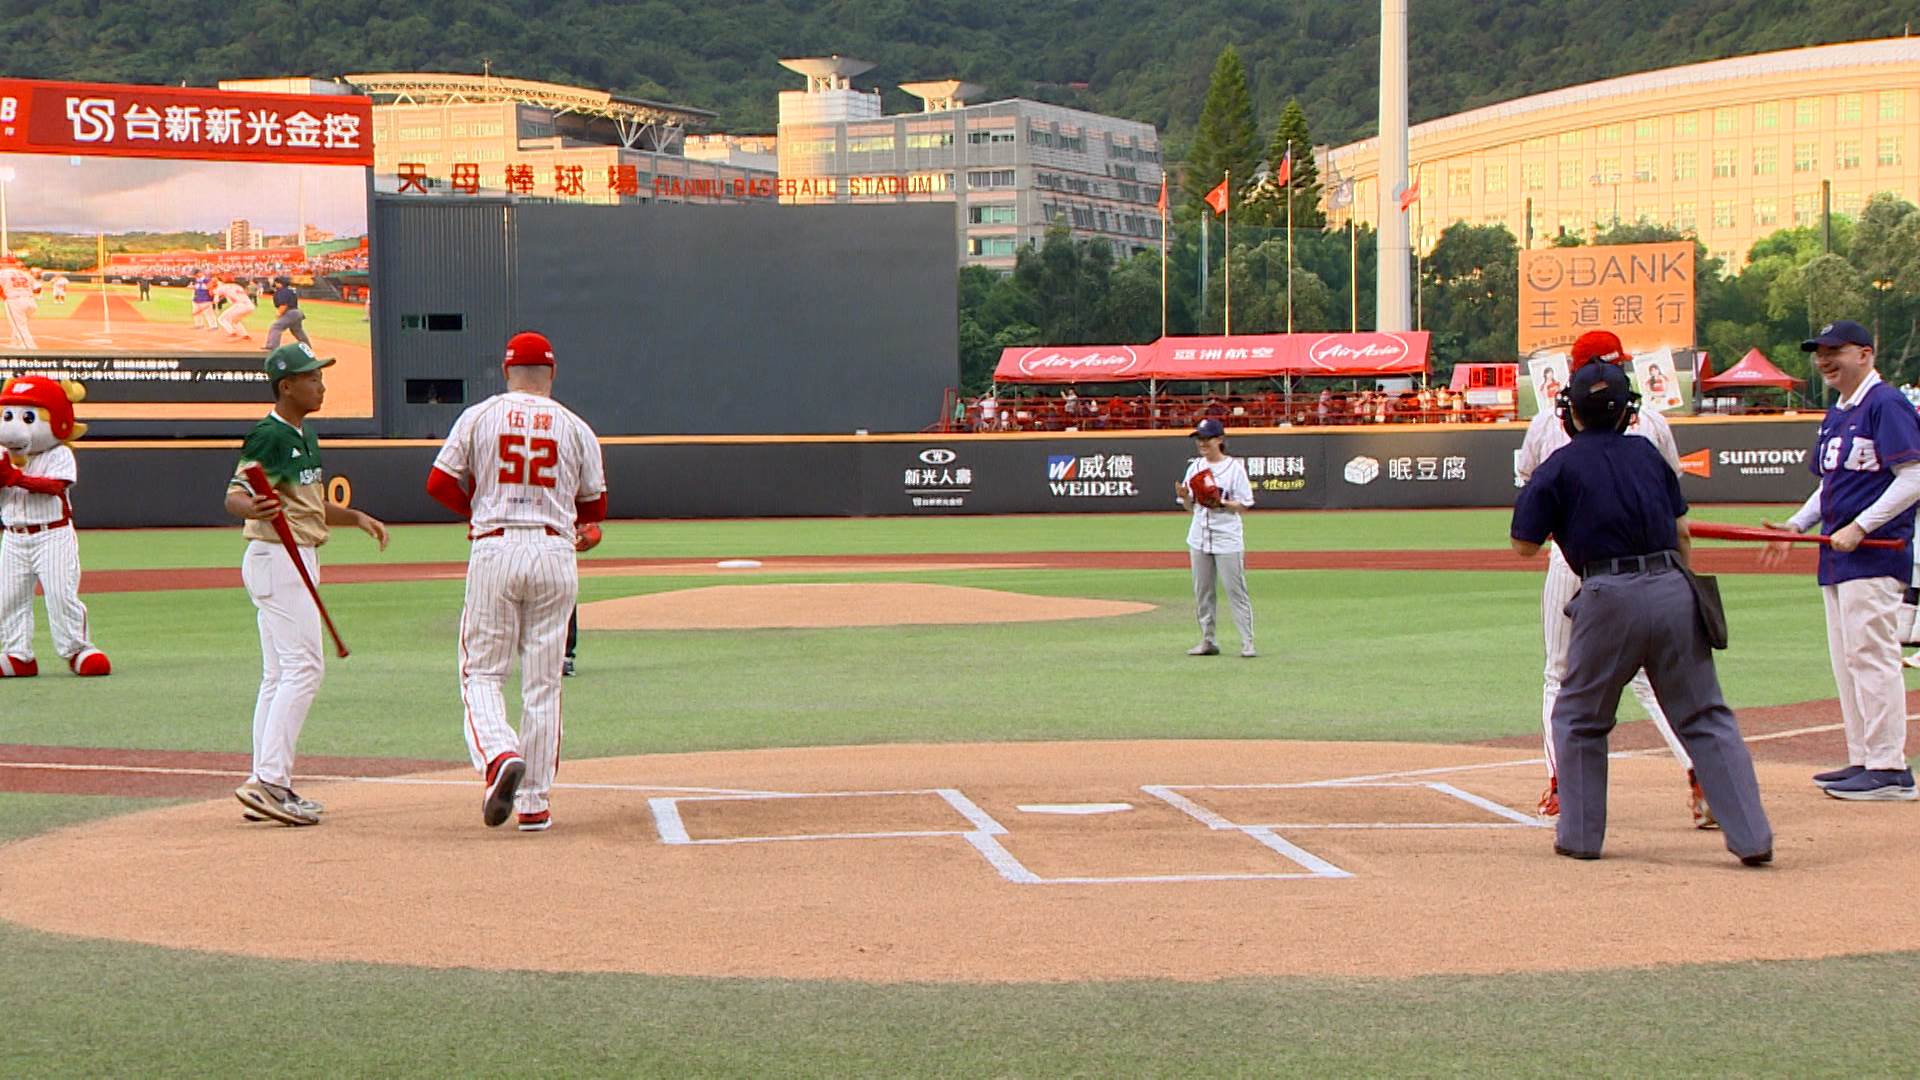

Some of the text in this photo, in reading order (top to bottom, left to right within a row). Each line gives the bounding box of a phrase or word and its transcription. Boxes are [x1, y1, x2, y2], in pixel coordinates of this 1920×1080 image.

[123, 103, 361, 149] 台新新光金控
[397, 162, 639, 196] 天母棒球場
[653, 175, 933, 197] TIANMU BASEBALL STADIUM
[1529, 292, 1688, 328] 王道銀行
[63, 359, 99, 369] Porter
[1173, 347, 1275, 360] 亞洲航空
[498, 434, 558, 488] 52
[1079, 454, 1134, 478] 威德
[1236, 456, 1305, 476] 爾眼科
[1719, 450, 1806, 465] SUNTORY
[1820, 436, 1881, 474] SA
[904, 467, 972, 486] 新光人壽
[1389, 456, 1466, 481] 眠豆腐
[1740, 466, 1785, 475] WELLNESS
